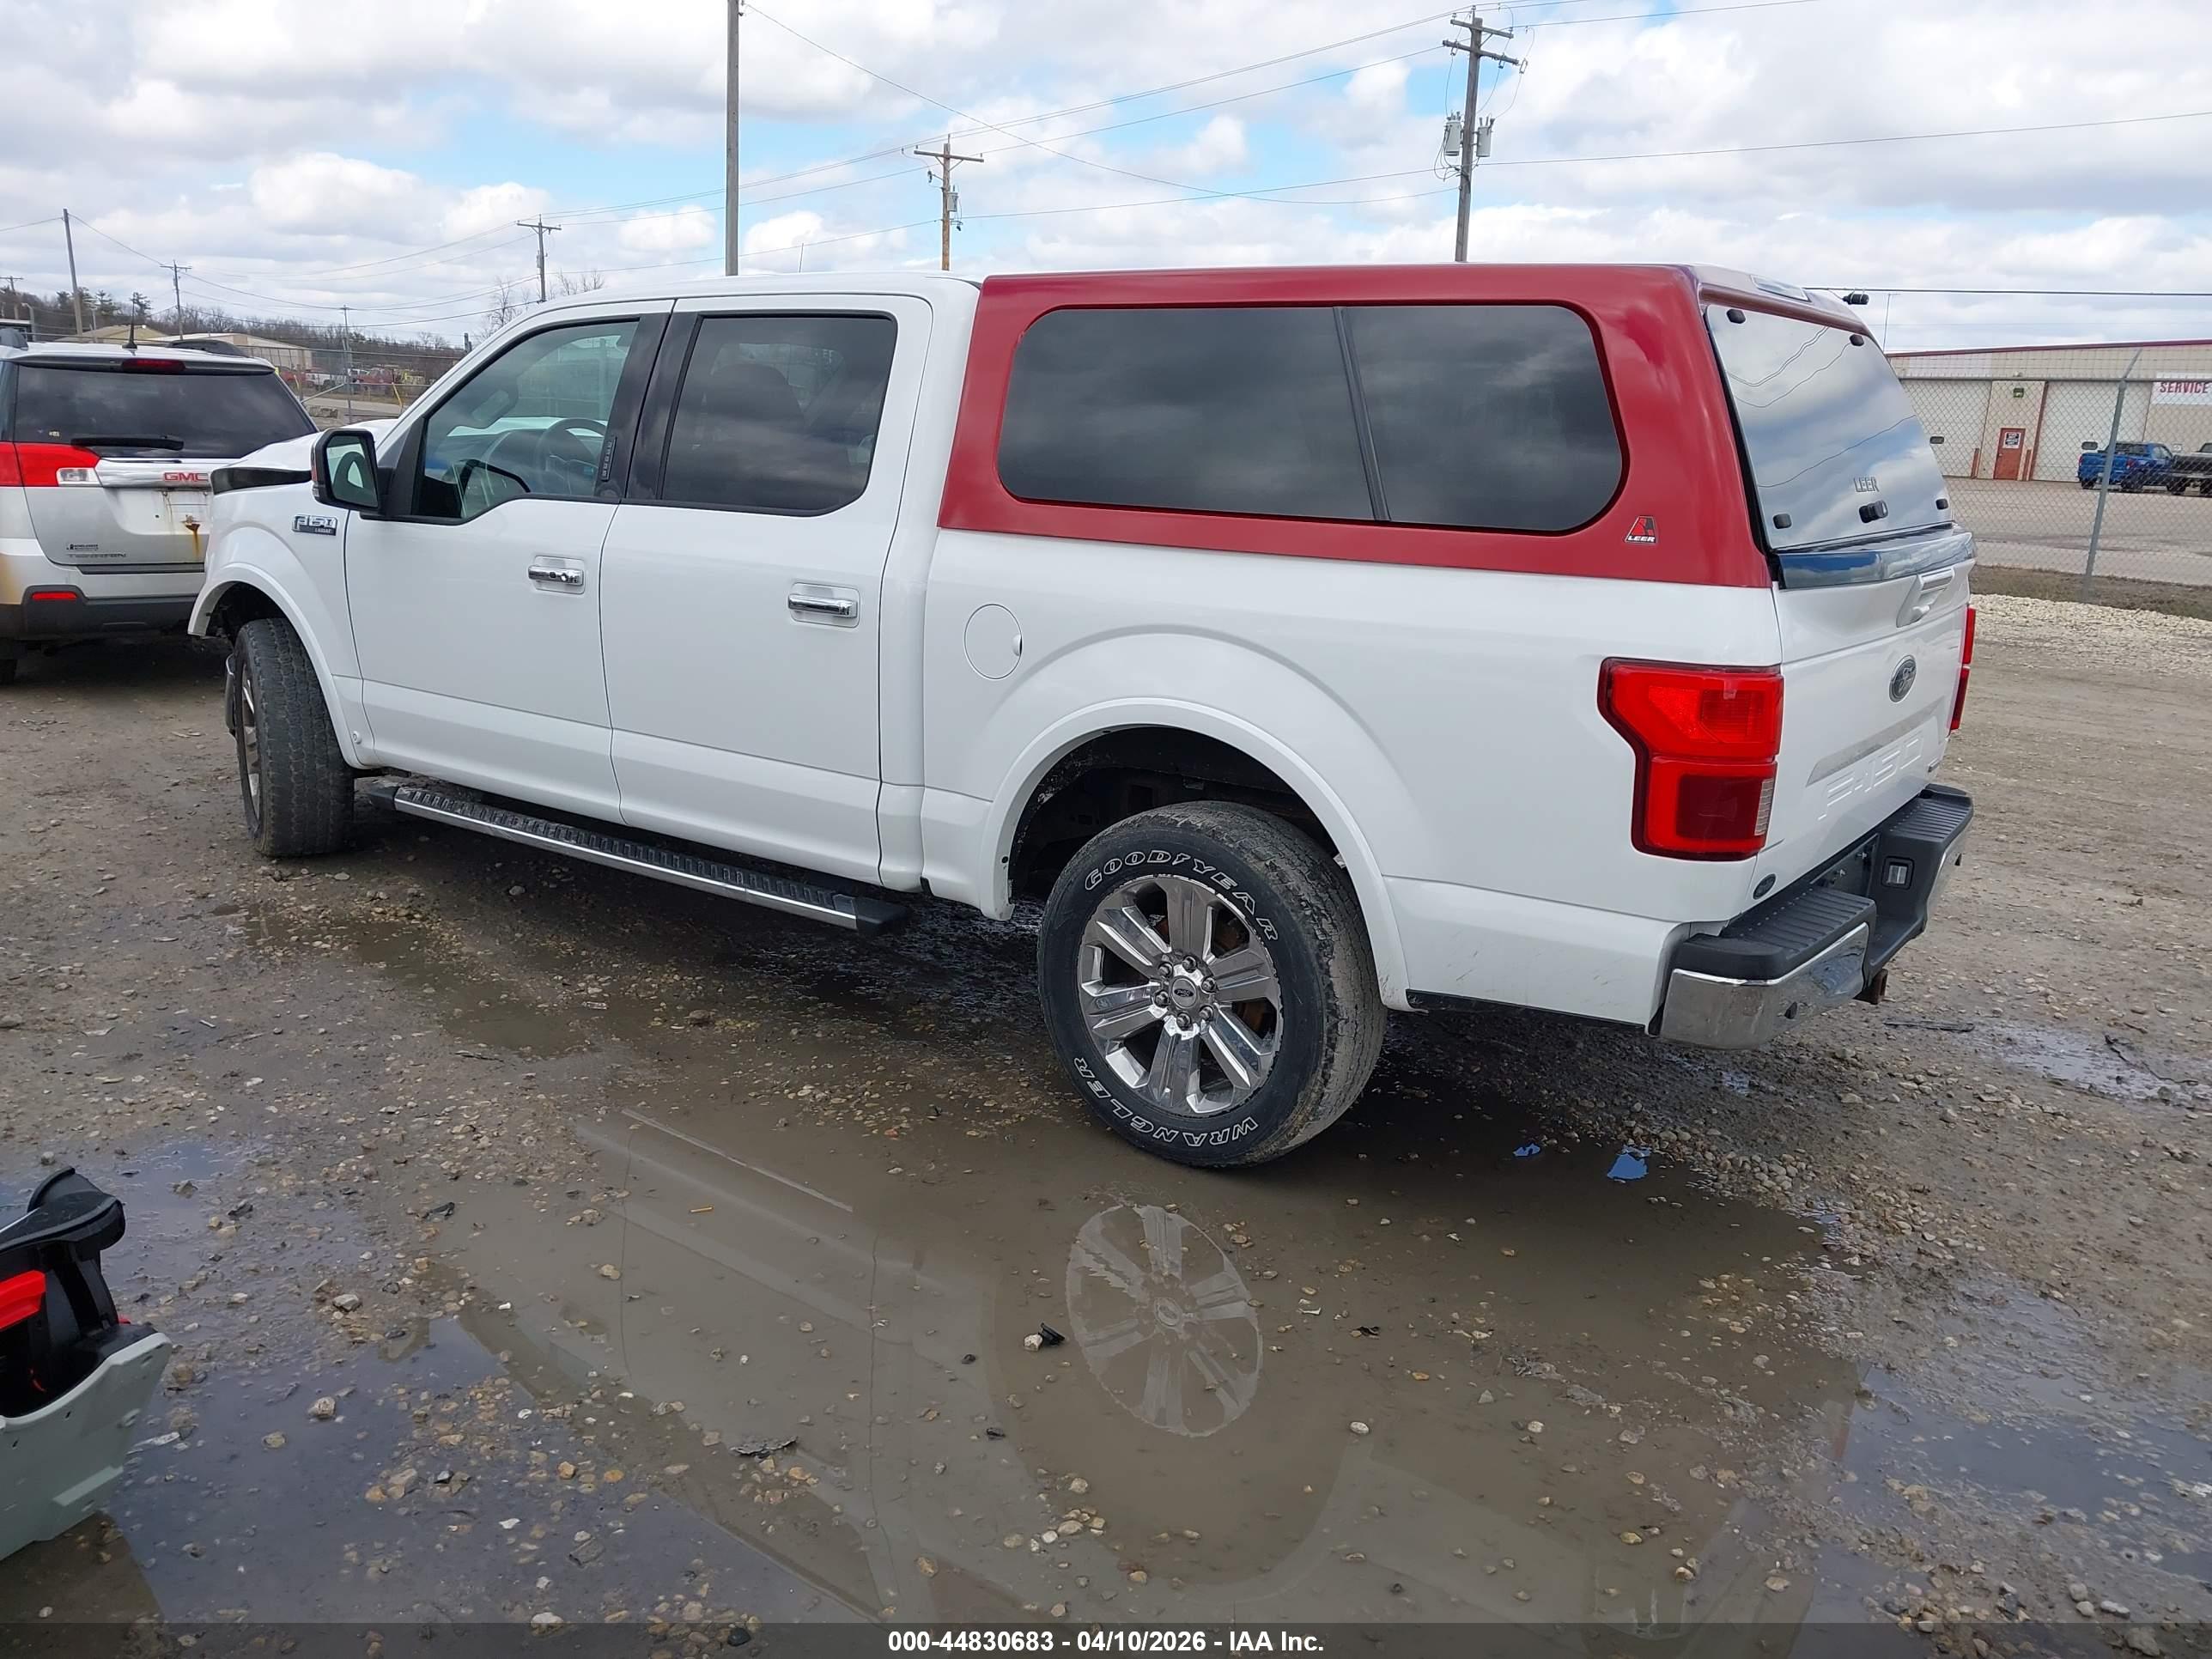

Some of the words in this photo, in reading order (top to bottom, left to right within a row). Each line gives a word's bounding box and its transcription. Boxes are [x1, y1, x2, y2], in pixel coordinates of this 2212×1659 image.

[2160, 381, 2208, 393] SERVICE
[164, 472, 208, 481] GMC
[1854, 477, 1880, 492] LEER
[1085, 850, 1279, 941] GOODYEAR
[1074, 1057, 1258, 1146] WRANGLER
